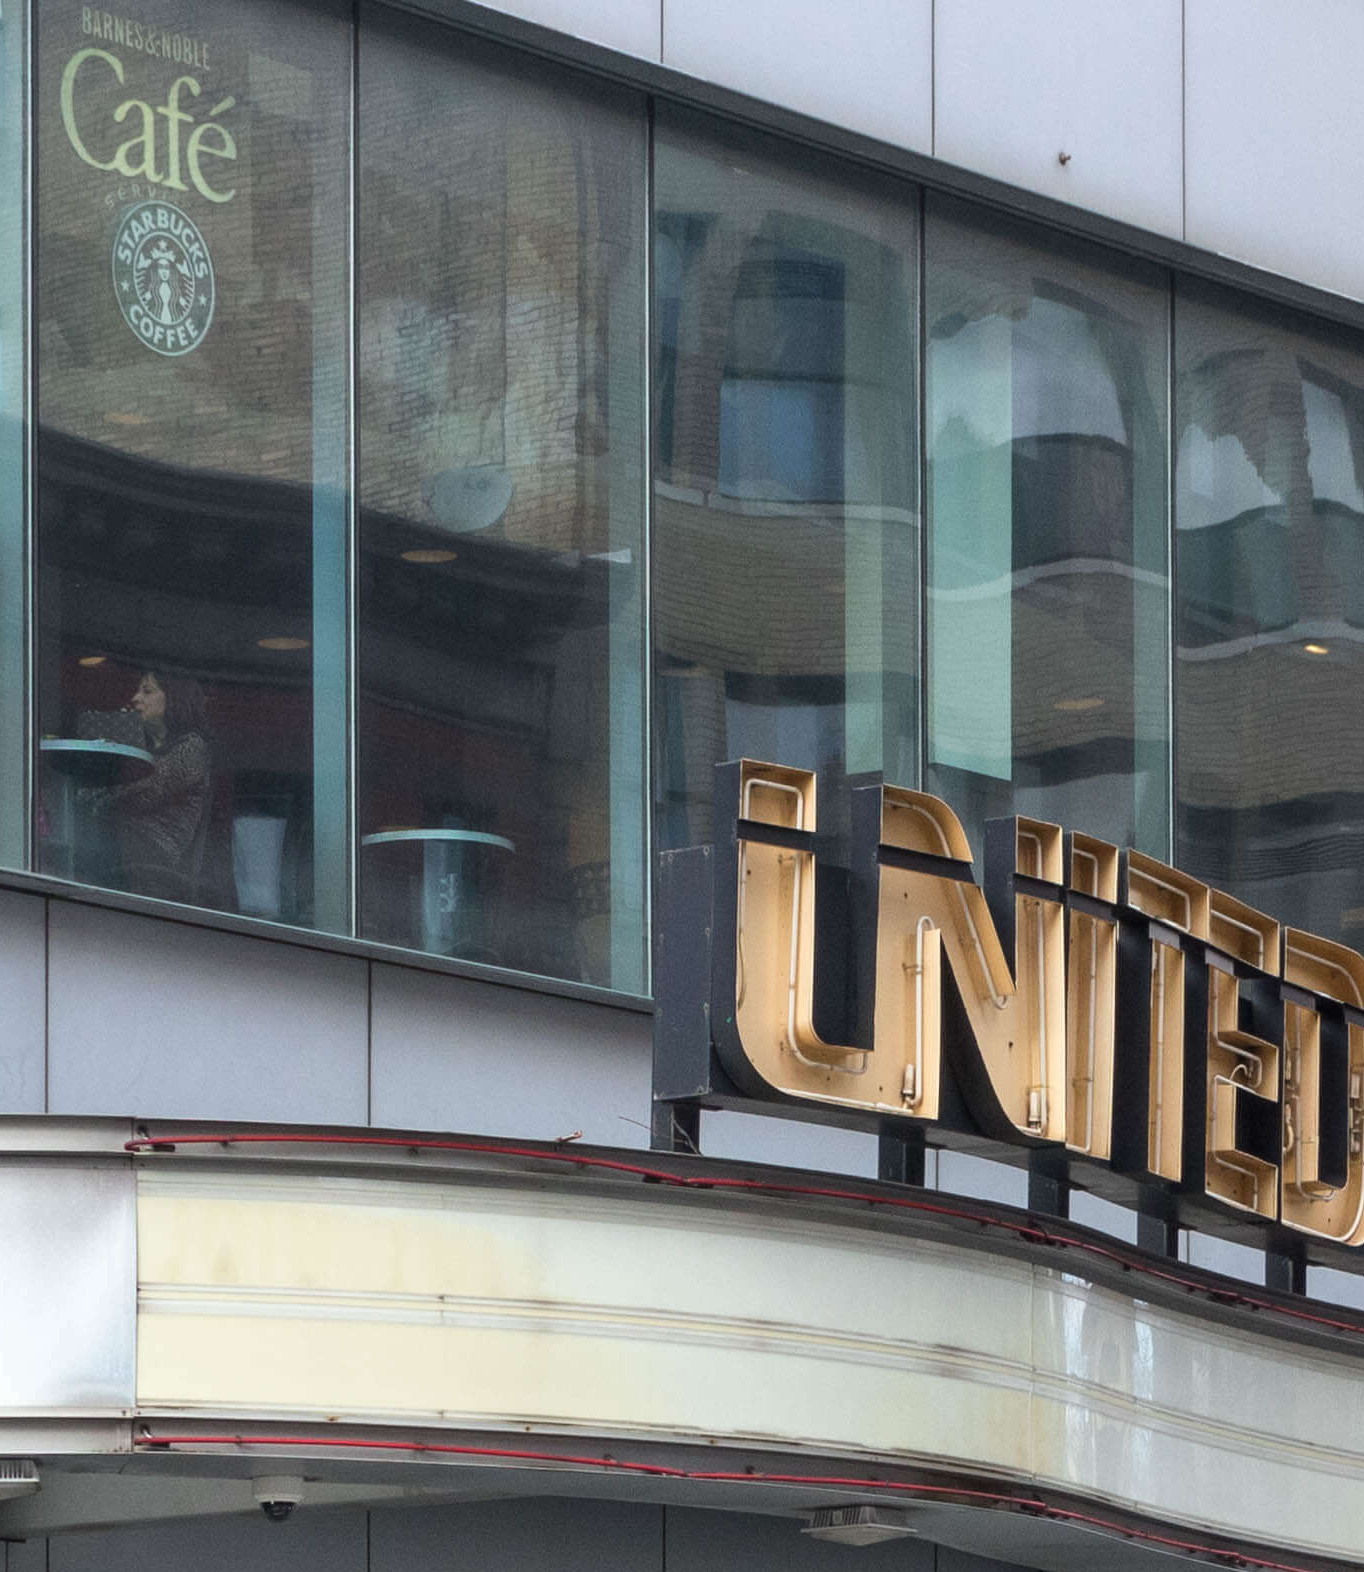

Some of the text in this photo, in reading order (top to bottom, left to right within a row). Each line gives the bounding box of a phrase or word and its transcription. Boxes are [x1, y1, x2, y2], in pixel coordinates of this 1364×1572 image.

[82, 6, 143, 50] BARNES
[162, 32, 211, 71] NOBLE
[61, 48, 237, 203] Café
[117, 208, 209, 280] STARBUCKS
[129, 305, 199, 350] COFFEE
